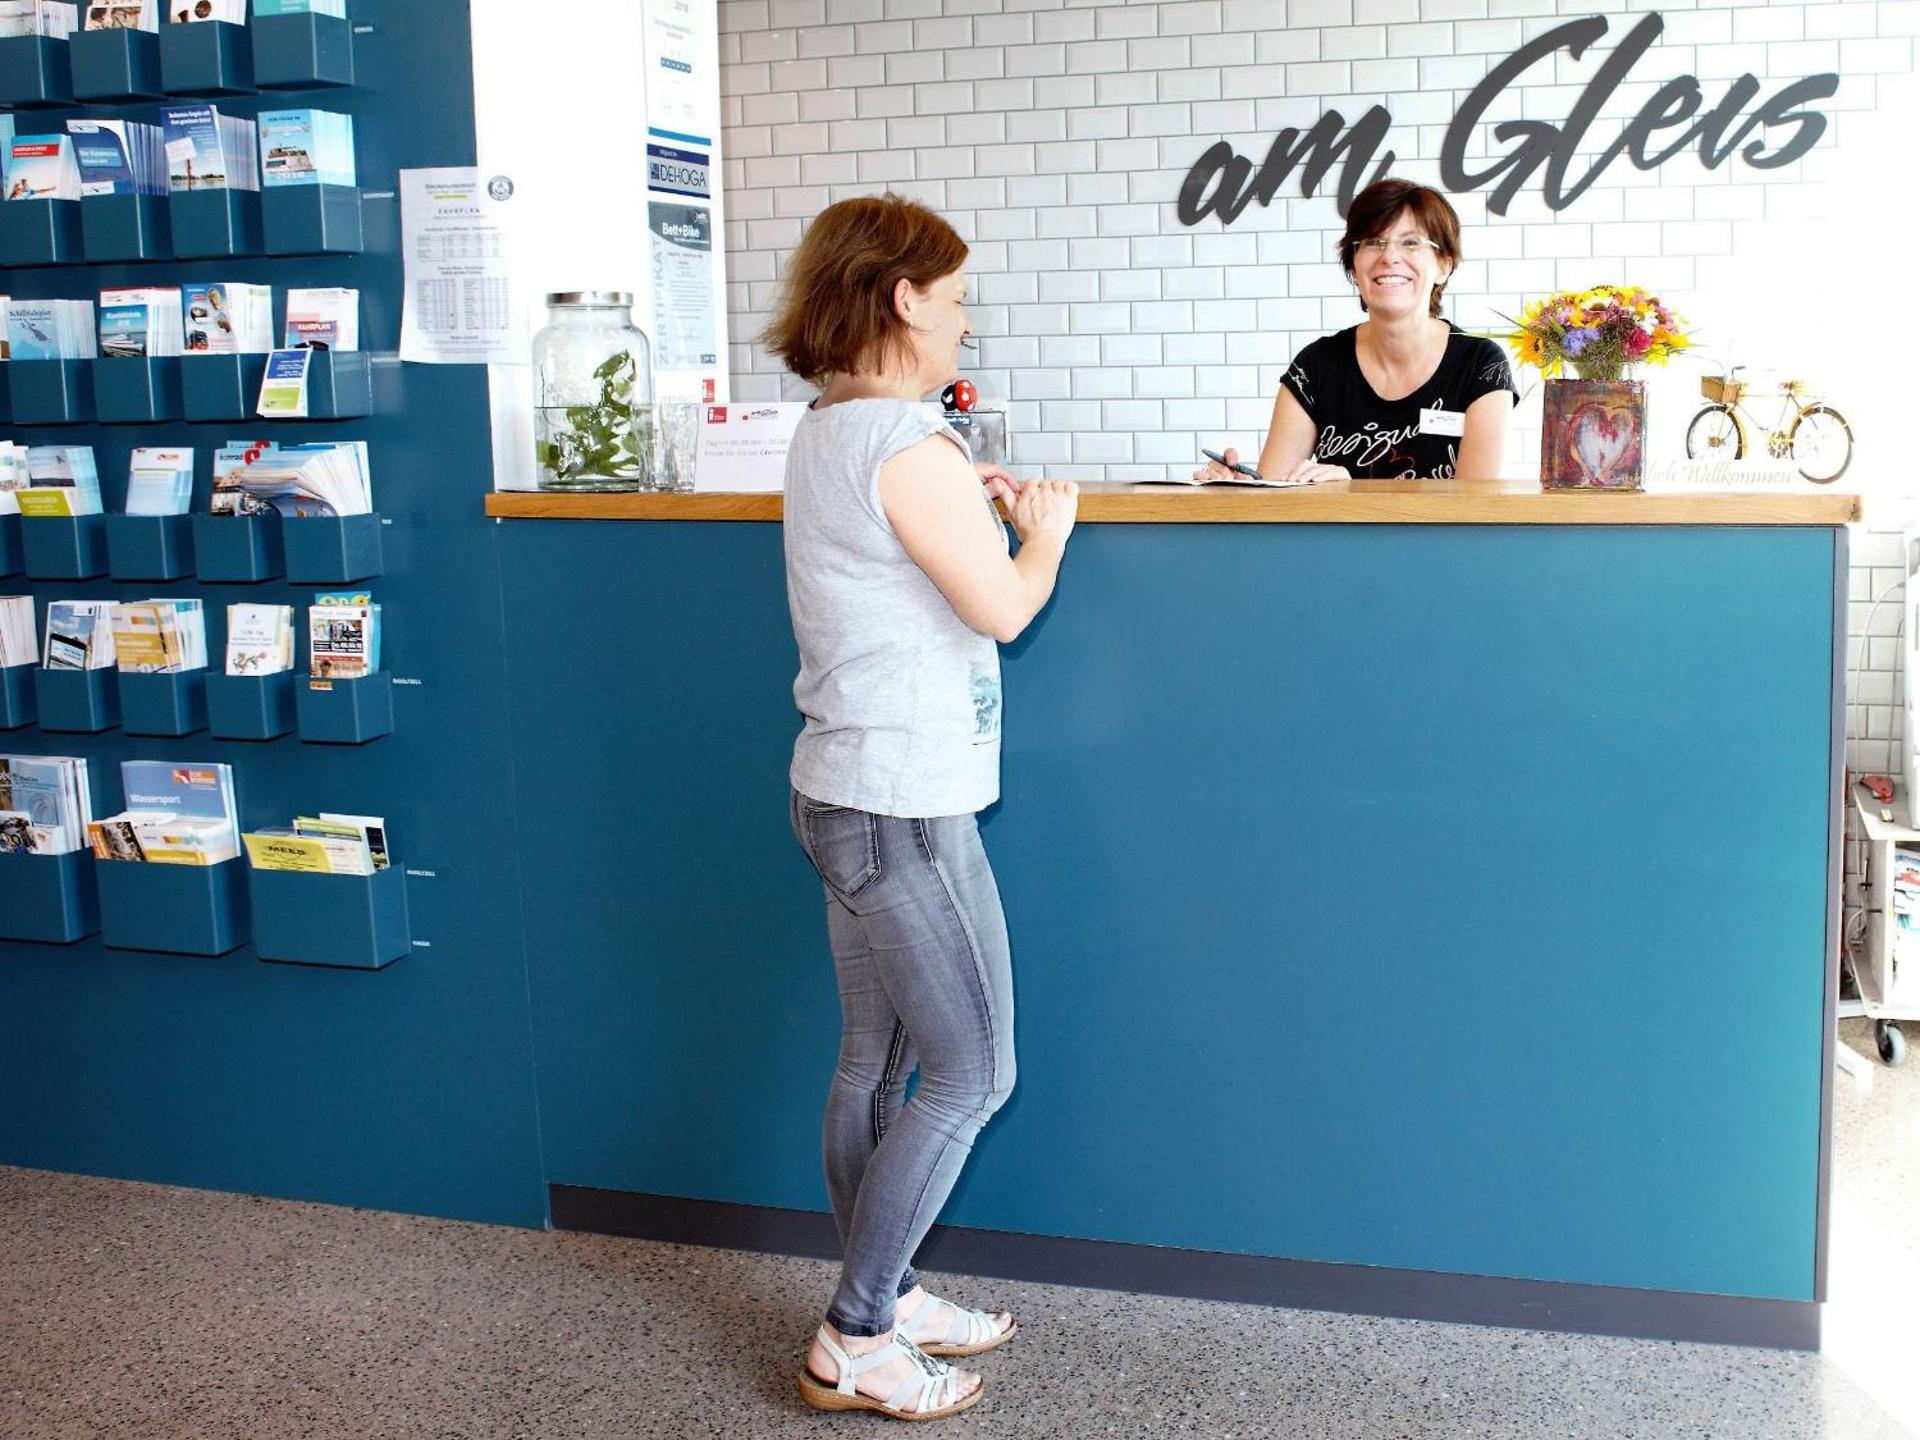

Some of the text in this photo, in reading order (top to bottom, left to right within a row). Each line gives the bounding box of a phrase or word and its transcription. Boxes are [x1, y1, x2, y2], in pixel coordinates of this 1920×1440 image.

[1177, 12, 1840, 226] am Gleis
[660, 164, 706, 188] DEHOGA
[662, 222, 700, 238] Bett+Bike
[1683, 462, 1792, 486] Willkommen
[129, 794, 181, 805] Wassersport
